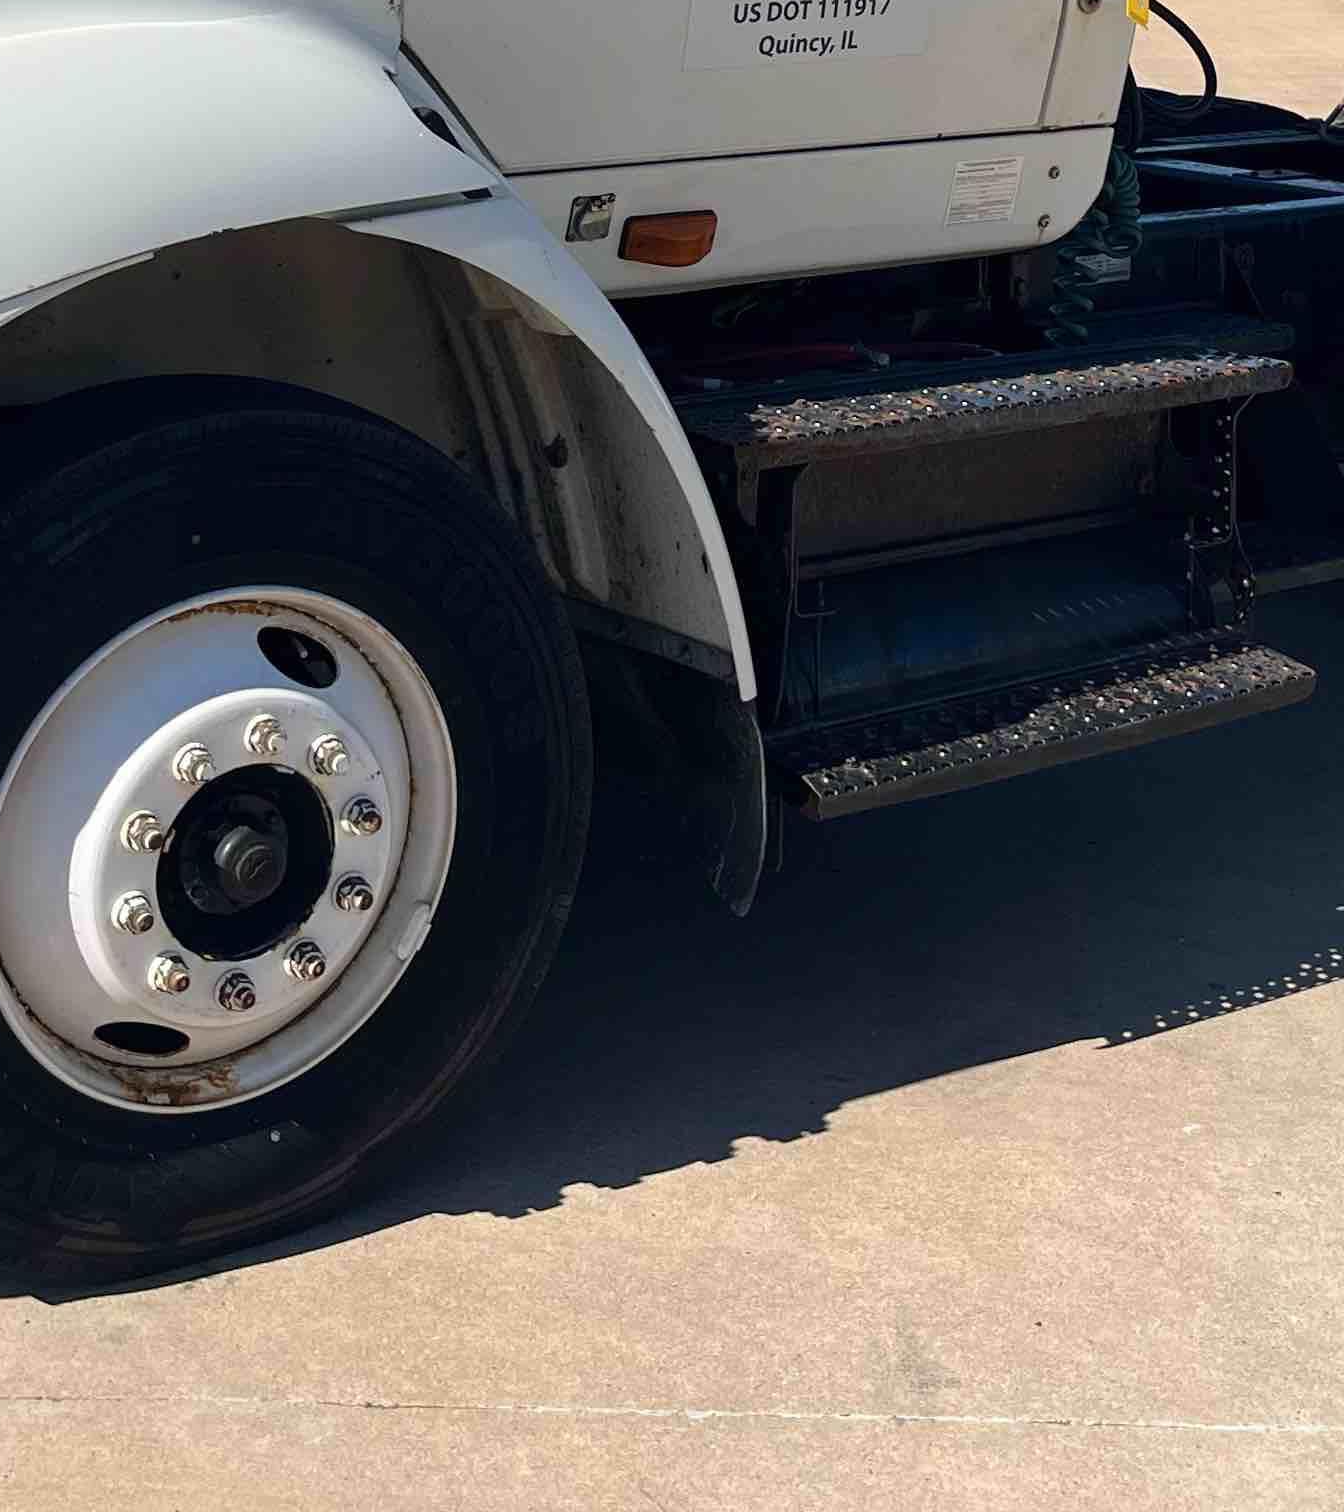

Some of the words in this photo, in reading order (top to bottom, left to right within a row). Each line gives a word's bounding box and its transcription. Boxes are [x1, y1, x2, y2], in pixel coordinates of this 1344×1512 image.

[733, 2, 762, 24] US
[767, 0, 813, 23] DOT
[758, 33, 835, 56] Quincy,
[840, 30, 859, 51] IL
